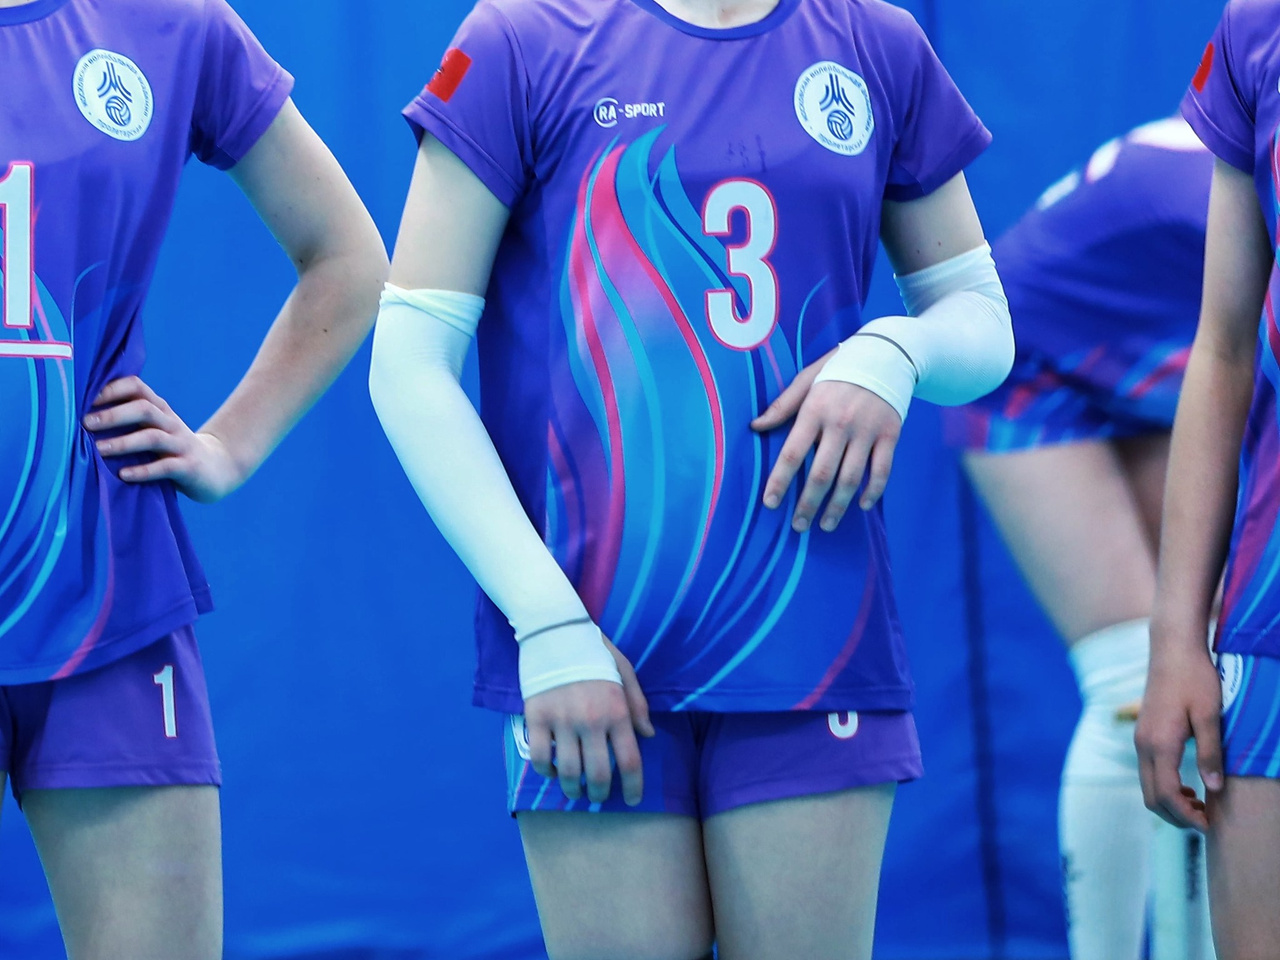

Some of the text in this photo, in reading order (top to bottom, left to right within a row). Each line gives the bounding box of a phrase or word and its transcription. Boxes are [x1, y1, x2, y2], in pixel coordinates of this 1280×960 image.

[596, 100, 666, 123] RA-SPORT
[703, 178, 779, 350] 3
[153, 664, 177, 738] 1
